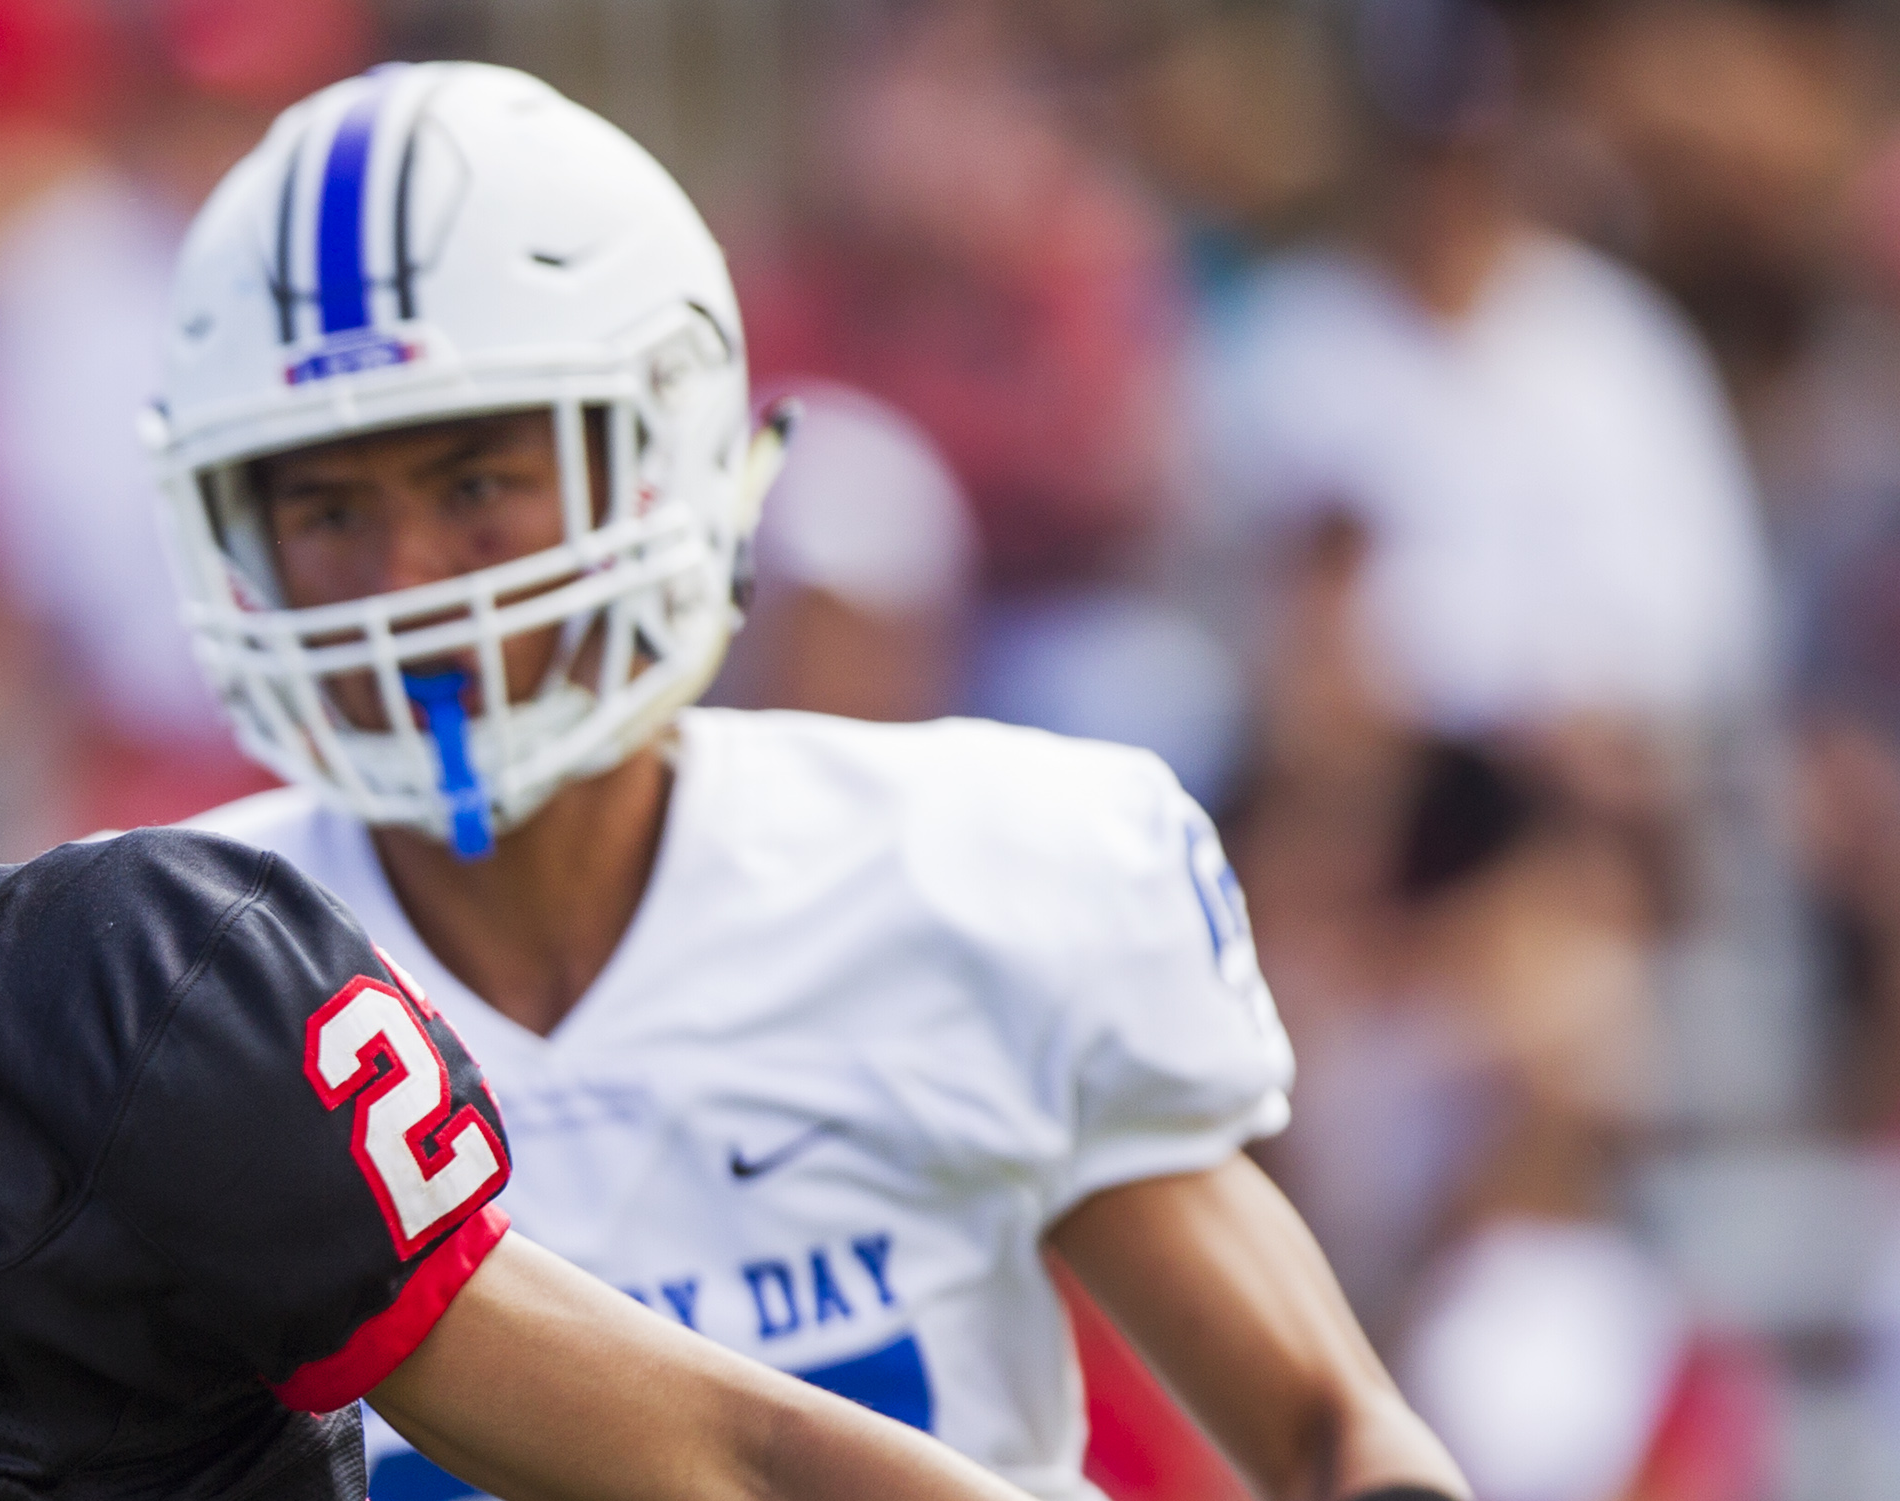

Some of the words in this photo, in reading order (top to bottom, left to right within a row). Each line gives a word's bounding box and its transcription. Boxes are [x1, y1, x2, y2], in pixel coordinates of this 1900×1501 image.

[303, 938, 512, 1263] 2
[618, 1276, 700, 1336] Y
[741, 1229, 895, 1340] DAY
